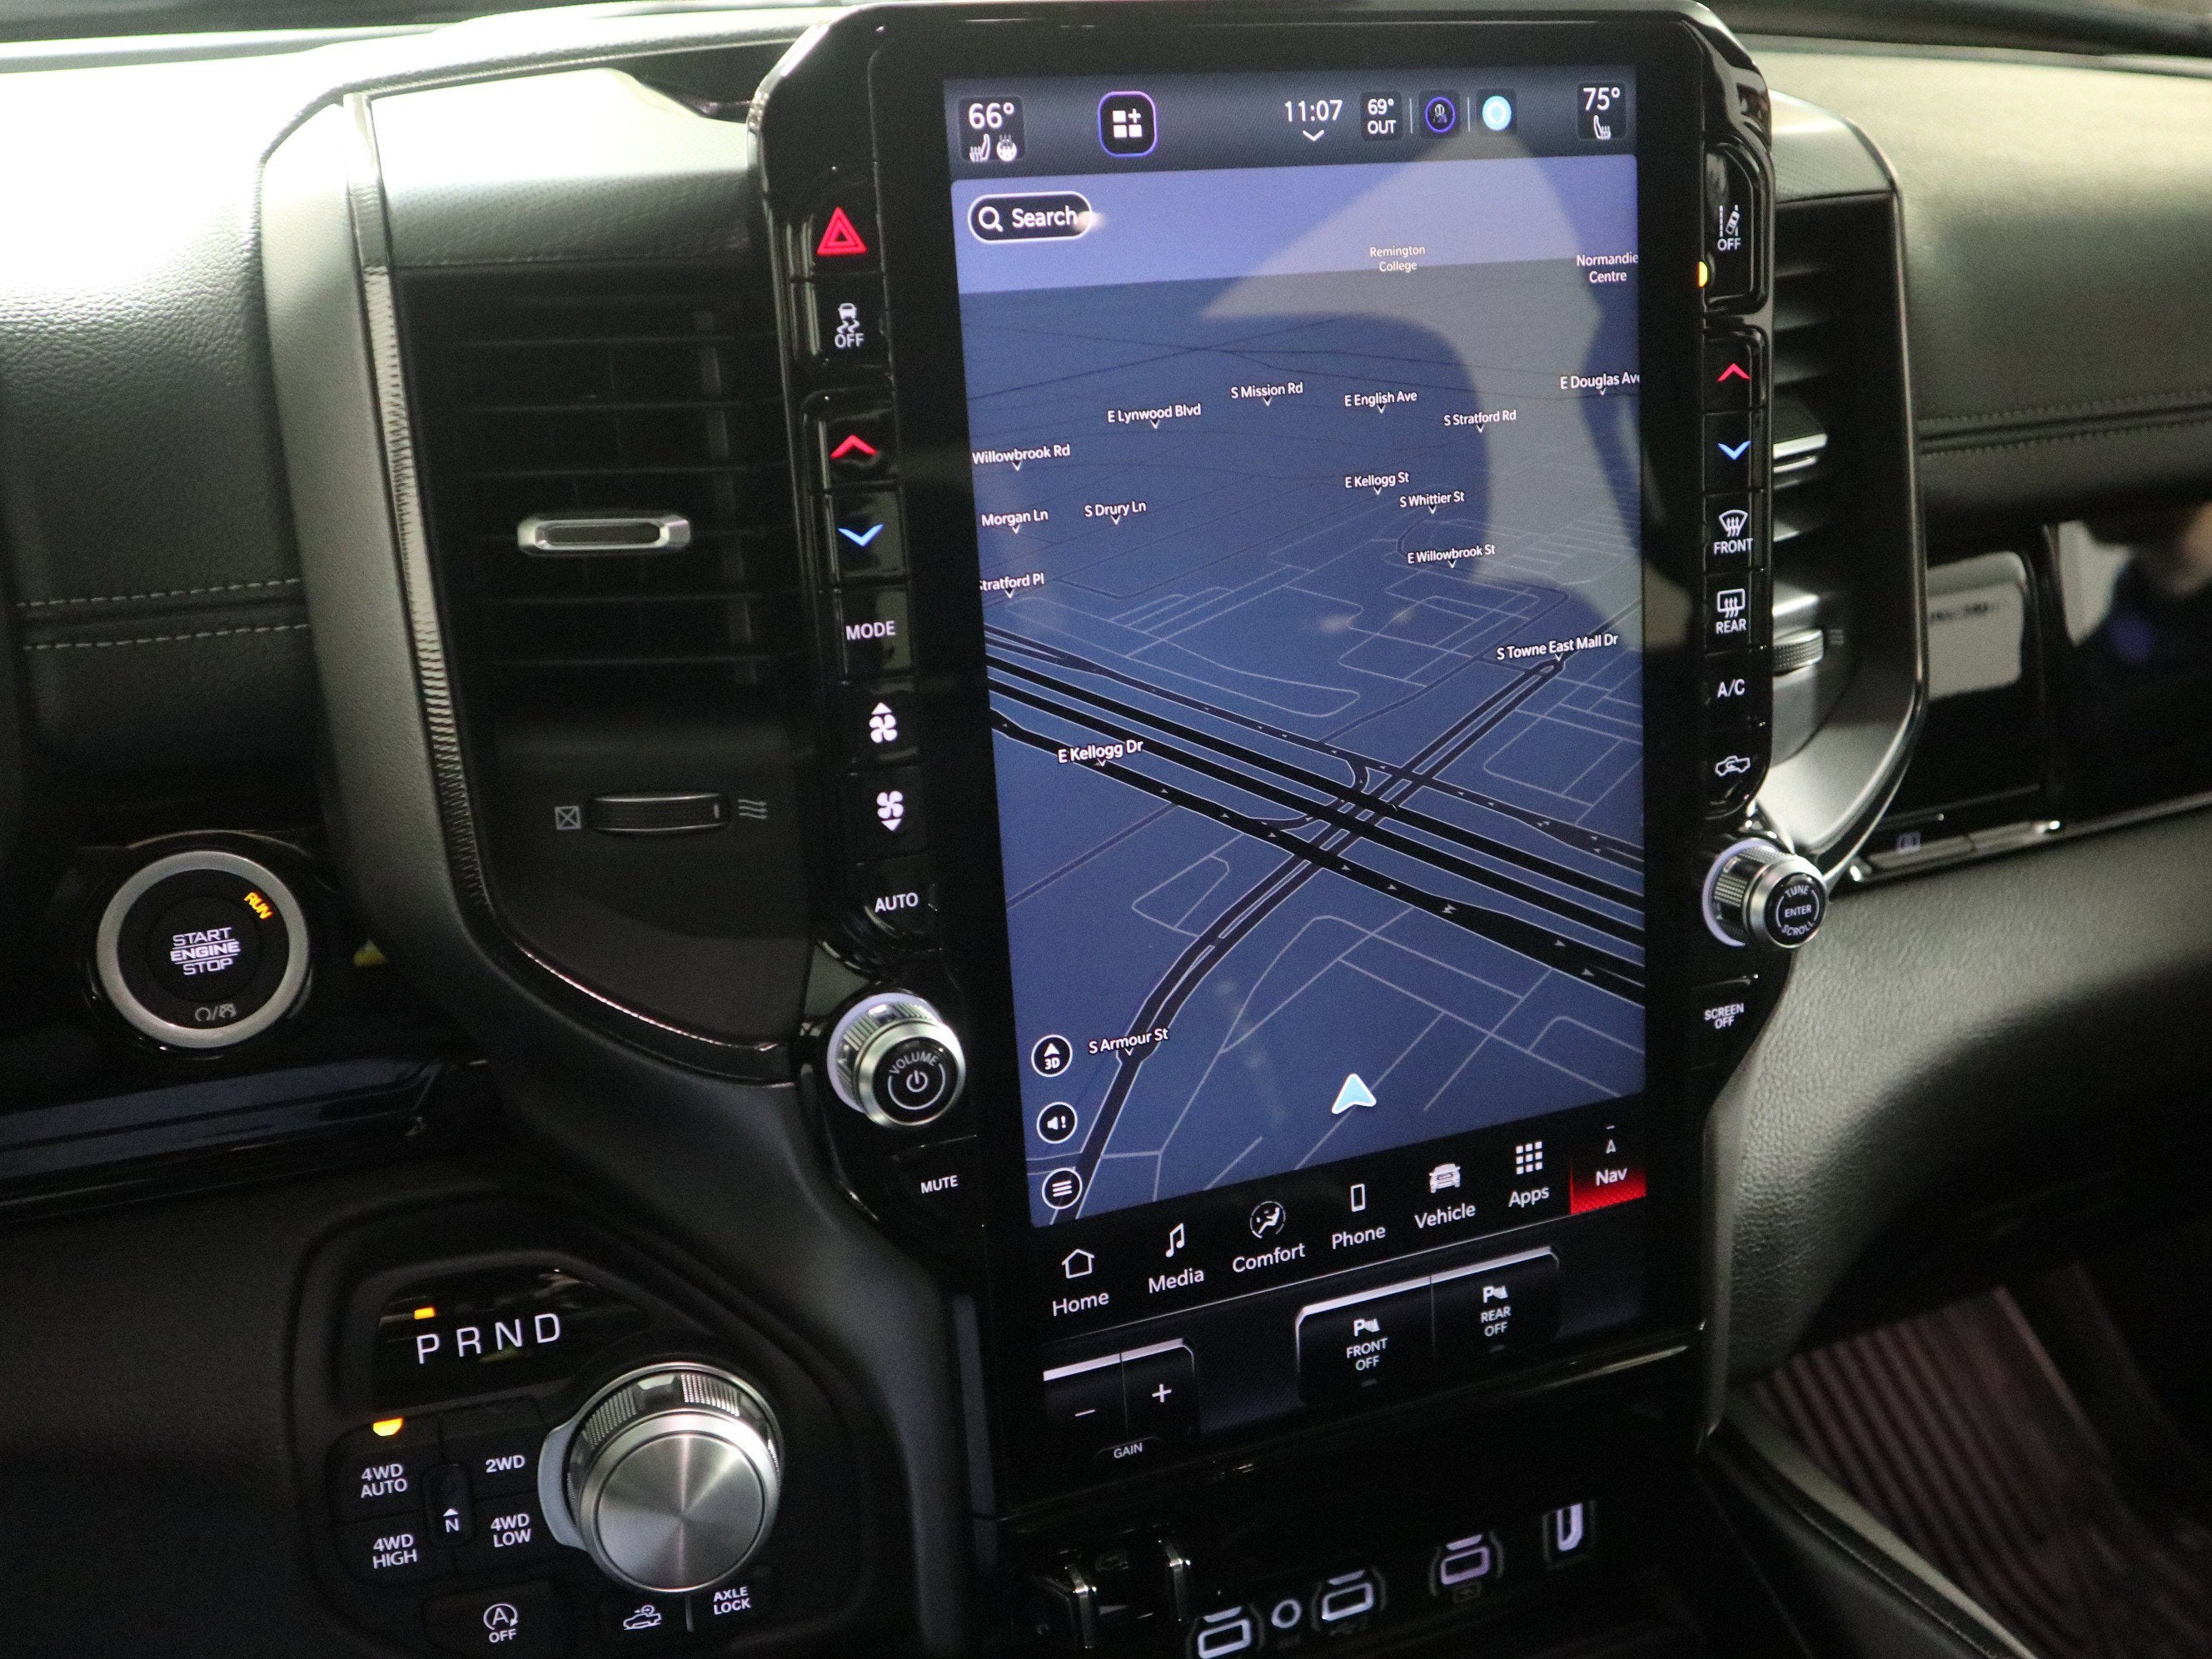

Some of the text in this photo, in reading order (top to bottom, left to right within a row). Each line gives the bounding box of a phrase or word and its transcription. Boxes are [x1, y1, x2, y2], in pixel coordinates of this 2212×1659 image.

[1368, 98, 1394, 116] 69°
[1583, 87, 1621, 111] 75°
[1284, 99, 1343, 122] 11:07
[1368, 120, 1397, 135] OUT
[1012, 206, 1078, 228] Search
[1369, 243, 1426, 259] Remington
[1716, 238, 1741, 251] OFF
[1379, 260, 1417, 273] College
[1577, 251, 1639, 267] Normandie
[1589, 271, 1627, 283] Centre
[834, 332, 864, 348] OFF
[1230, 381, 1303, 399] S Mission Rd
[1560, 376, 1568, 390] E
[1571, 373, 1620, 390] Douglas
[1344, 391, 1417, 408] E English Ave
[1108, 403, 1202, 424] E Lynwood Blvd
[1443, 409, 1517, 426] S Stratford Rd
[972, 444, 1071, 464] Willowbrook Rd
[1345, 471, 1409, 490] E Kellogg St
[1399, 491, 1465, 508] S Whittier St
[981, 510, 1049, 527] Morgan Ln
[1084, 501, 1146, 518] S Drury Ln
[1407, 544, 1496, 564] E Willowbrook St
[1713, 538, 1753, 555] FRONT
[979, 572, 1044, 590] tratford Pl
[845, 620, 896, 640] MODE
[1716, 618, 1746, 635] REAR
[1497, 633, 1618, 660] S Towne East Mall Dr
[1717, 679, 1746, 698] A/C
[1058, 740, 1143, 764] E Kellogg Dr
[1785, 884, 1811, 899] TUNE
[243, 891, 274, 919] RUN
[874, 892, 919, 914] AUTO
[1785, 904, 1812, 918] ENTER
[172, 926, 232, 947] START
[1781, 920, 1815, 936] SCROLL
[170, 941, 241, 962] ENGINE
[183, 958, 233, 976] STOP
[1704, 1003, 1745, 1021] SCREEN
[1714, 1015, 1735, 1029] OFF
[1089, 1027, 1168, 1055] S Armour St
[889, 1053, 939, 1077] VOLUME
[1044, 1056, 1060, 1071] 3D
[920, 1175, 959, 1194] MUTE
[1595, 1168, 1628, 1187] Nav
[1508, 1186, 1550, 1209] Apps
[1414, 1202, 1476, 1229] Vehicle
[1332, 1225, 1387, 1250] Phone
[1232, 1242, 1306, 1273] Comfort
[1148, 1268, 1204, 1293] Media
[1052, 1292, 1109, 1317] Home
[1481, 1306, 1511, 1324] REAR
[1484, 1321, 1507, 1338] OFF
[1346, 1338, 1388, 1359] FRONT
[1355, 1355, 1380, 1373] OFF
[1113, 1442, 1143, 1459] GAIN
[361, 1463, 404, 1482] 4WD
[486, 1454, 526, 1473] 2WD
[361, 1478, 408, 1498] AUTO
[445, 1518, 460, 1533] N
[491, 1513, 531, 1532] 4WD
[372, 1533, 414, 1552] 4WD
[493, 1528, 531, 1548] LOW
[372, 1549, 417, 1569] HIGH
[714, 1587, 749, 1602] AXLE
[714, 1597, 750, 1616] LOCK
[489, 1628, 517, 1643] OFF
